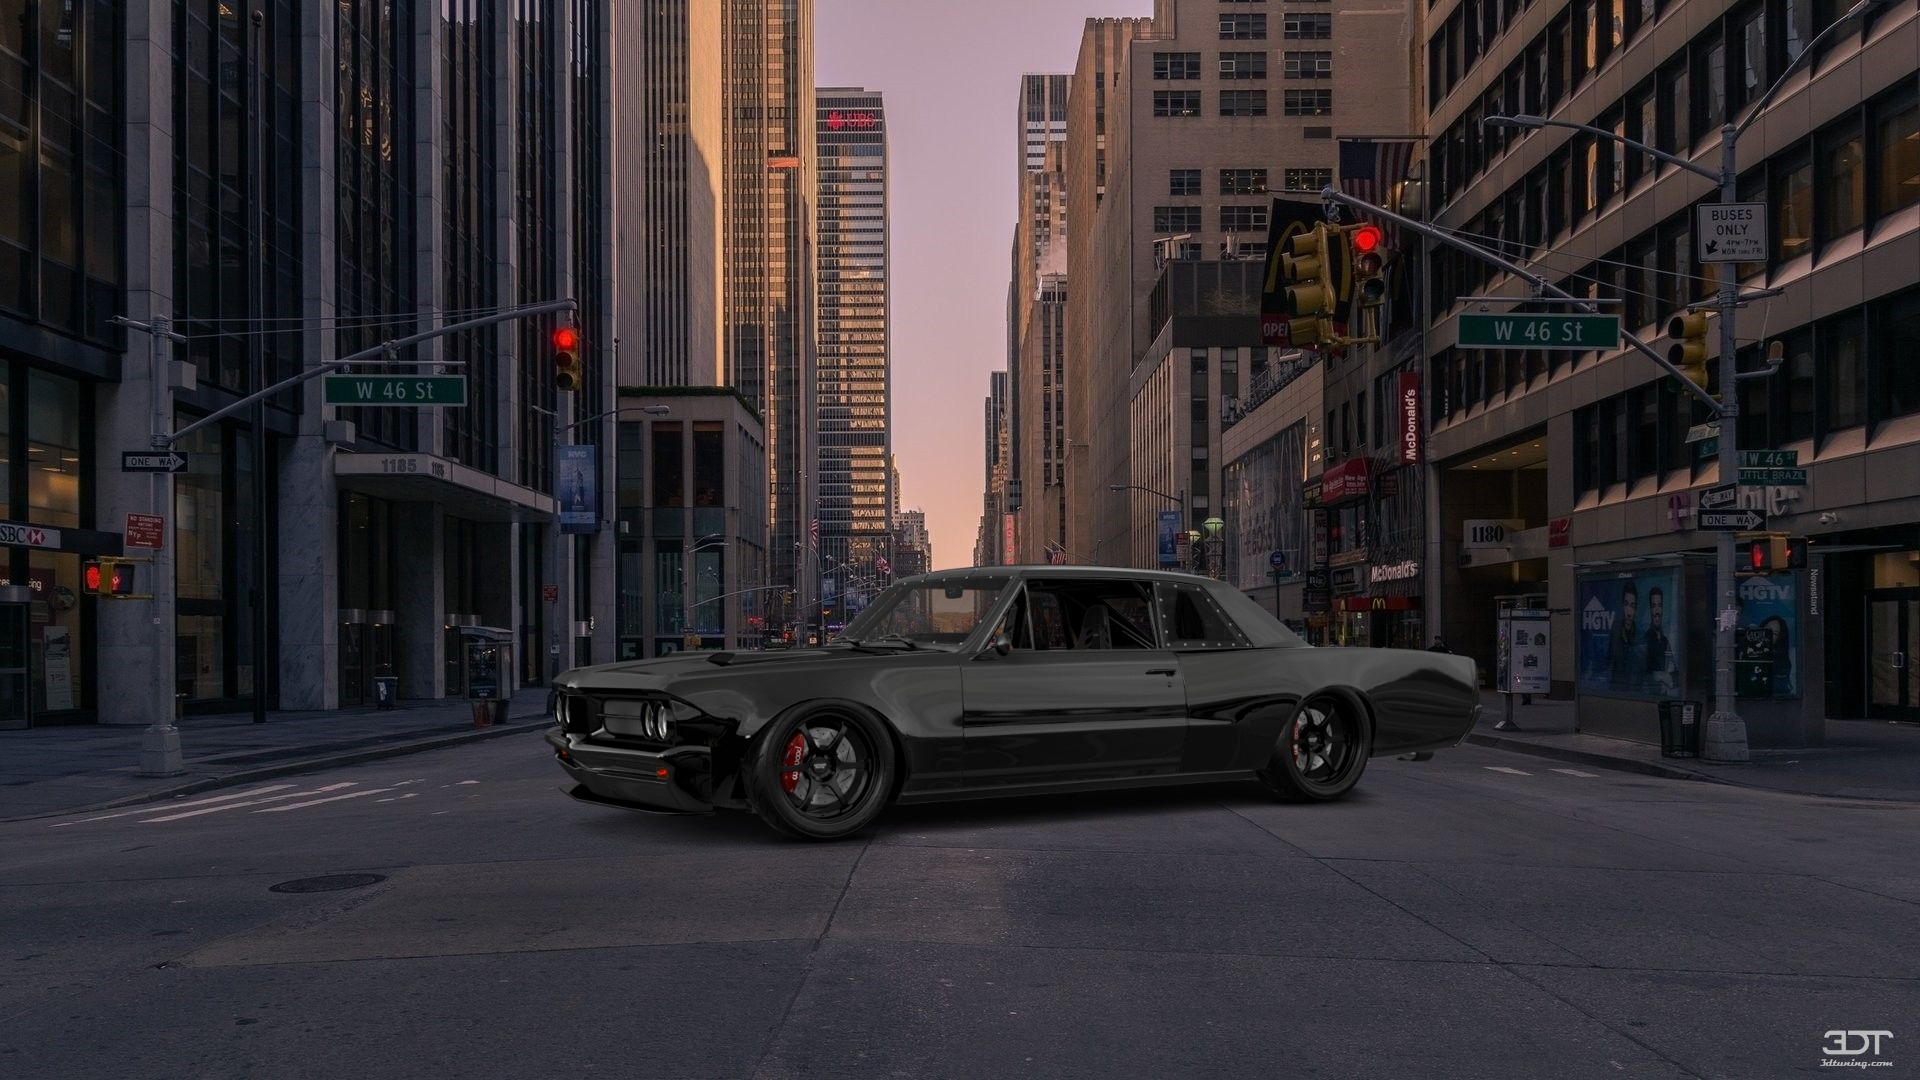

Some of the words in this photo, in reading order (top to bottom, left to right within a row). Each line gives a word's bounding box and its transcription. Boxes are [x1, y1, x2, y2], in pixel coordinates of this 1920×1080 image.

[1711, 209, 1752, 220] BUSES
[1716, 225, 1748, 235] ONLY
[1263, 322, 1289, 337] OPE
[1494, 321, 1513, 341] W
[1524, 321, 1551, 341] 46
[1561, 322, 1583, 342] St
[356, 381, 373, 399] W
[383, 382, 406, 399] 46
[415, 382, 434, 399] St
[1404, 389, 1417, 460] McDonald's
[130, 457, 150, 466] ONE
[158, 458, 178, 466] WAY
[381, 458, 417, 473] 1185
[1749, 452, 1760, 466] W
[1766, 454, 1784, 466] 46
[1739, 470, 1769, 480] LITTLE
[1772, 470, 1806, 480] BRAZIL
[1706, 516, 1728, 525] ONE
[1735, 516, 1757, 525] WAY
[1471, 525, 1504, 543] 1180
[1371, 560, 1421, 583] McDonald's
[1738, 584, 1791, 601] HGTV
[1582, 610, 1615, 630] HGTV
